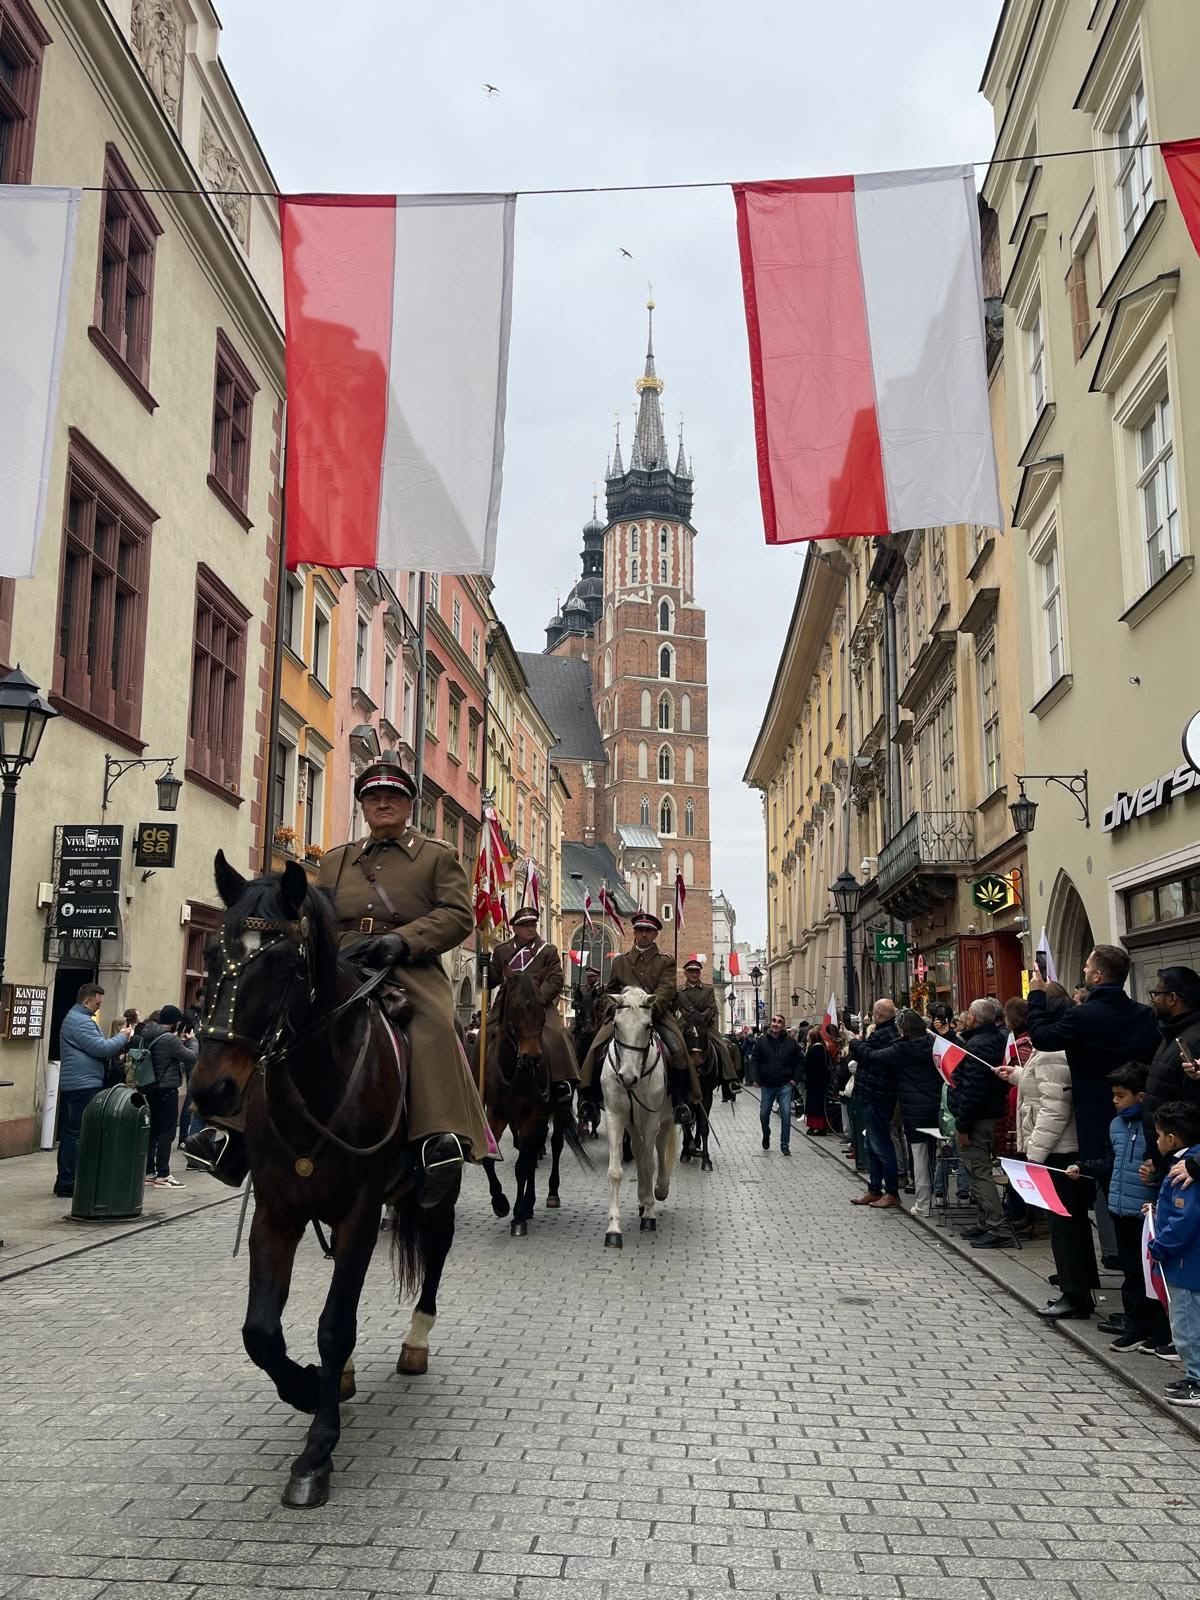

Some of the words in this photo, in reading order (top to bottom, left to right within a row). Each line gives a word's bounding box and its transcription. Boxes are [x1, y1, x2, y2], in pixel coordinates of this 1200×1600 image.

[143, 827, 170, 841] de
[64, 836, 85, 846] VIVA
[97, 837, 120, 846] PINTA
[142, 841, 168, 853] sa
[72, 928, 103, 939] HOSTEL
[15, 987, 46, 1000] KANTOR
[13, 1005, 28, 1015] USD
[12, 1016, 27, 1025] EUR
[11, 1026, 26, 1036] GBP
